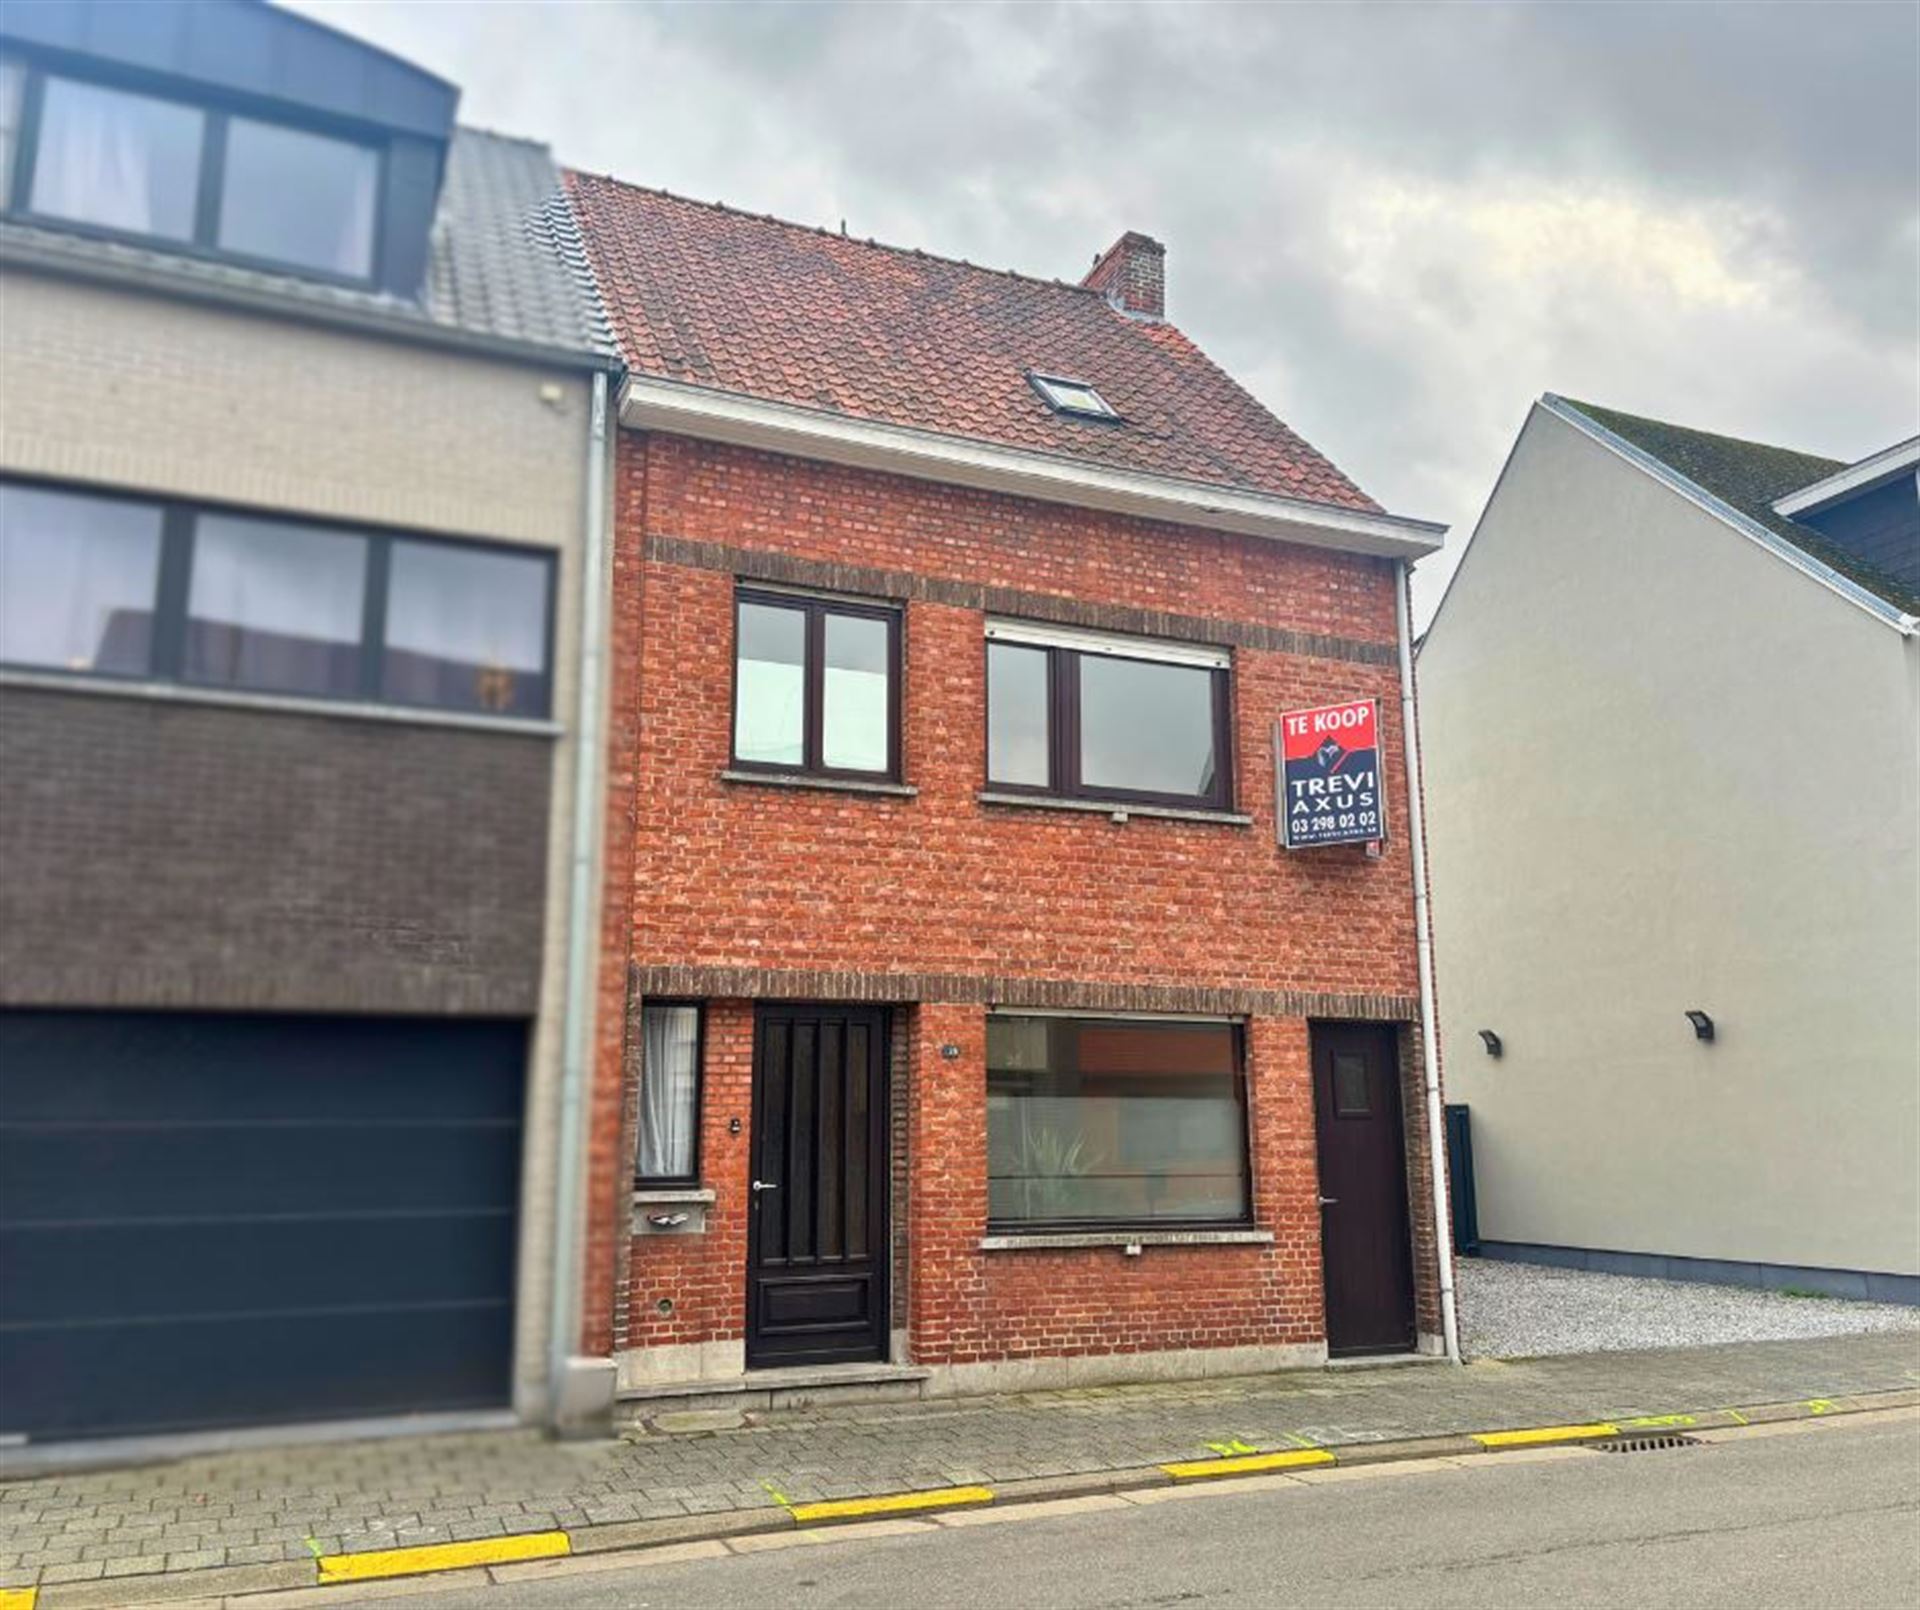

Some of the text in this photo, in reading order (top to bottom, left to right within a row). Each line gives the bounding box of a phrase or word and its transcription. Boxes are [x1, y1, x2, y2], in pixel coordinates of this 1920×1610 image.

[1287, 706, 1369, 736] TE KOOP
[1291, 771, 1375, 797] TREVI
[1292, 792, 1374, 815] AXUS
[1291, 811, 1376, 833] 03 298 02 02
